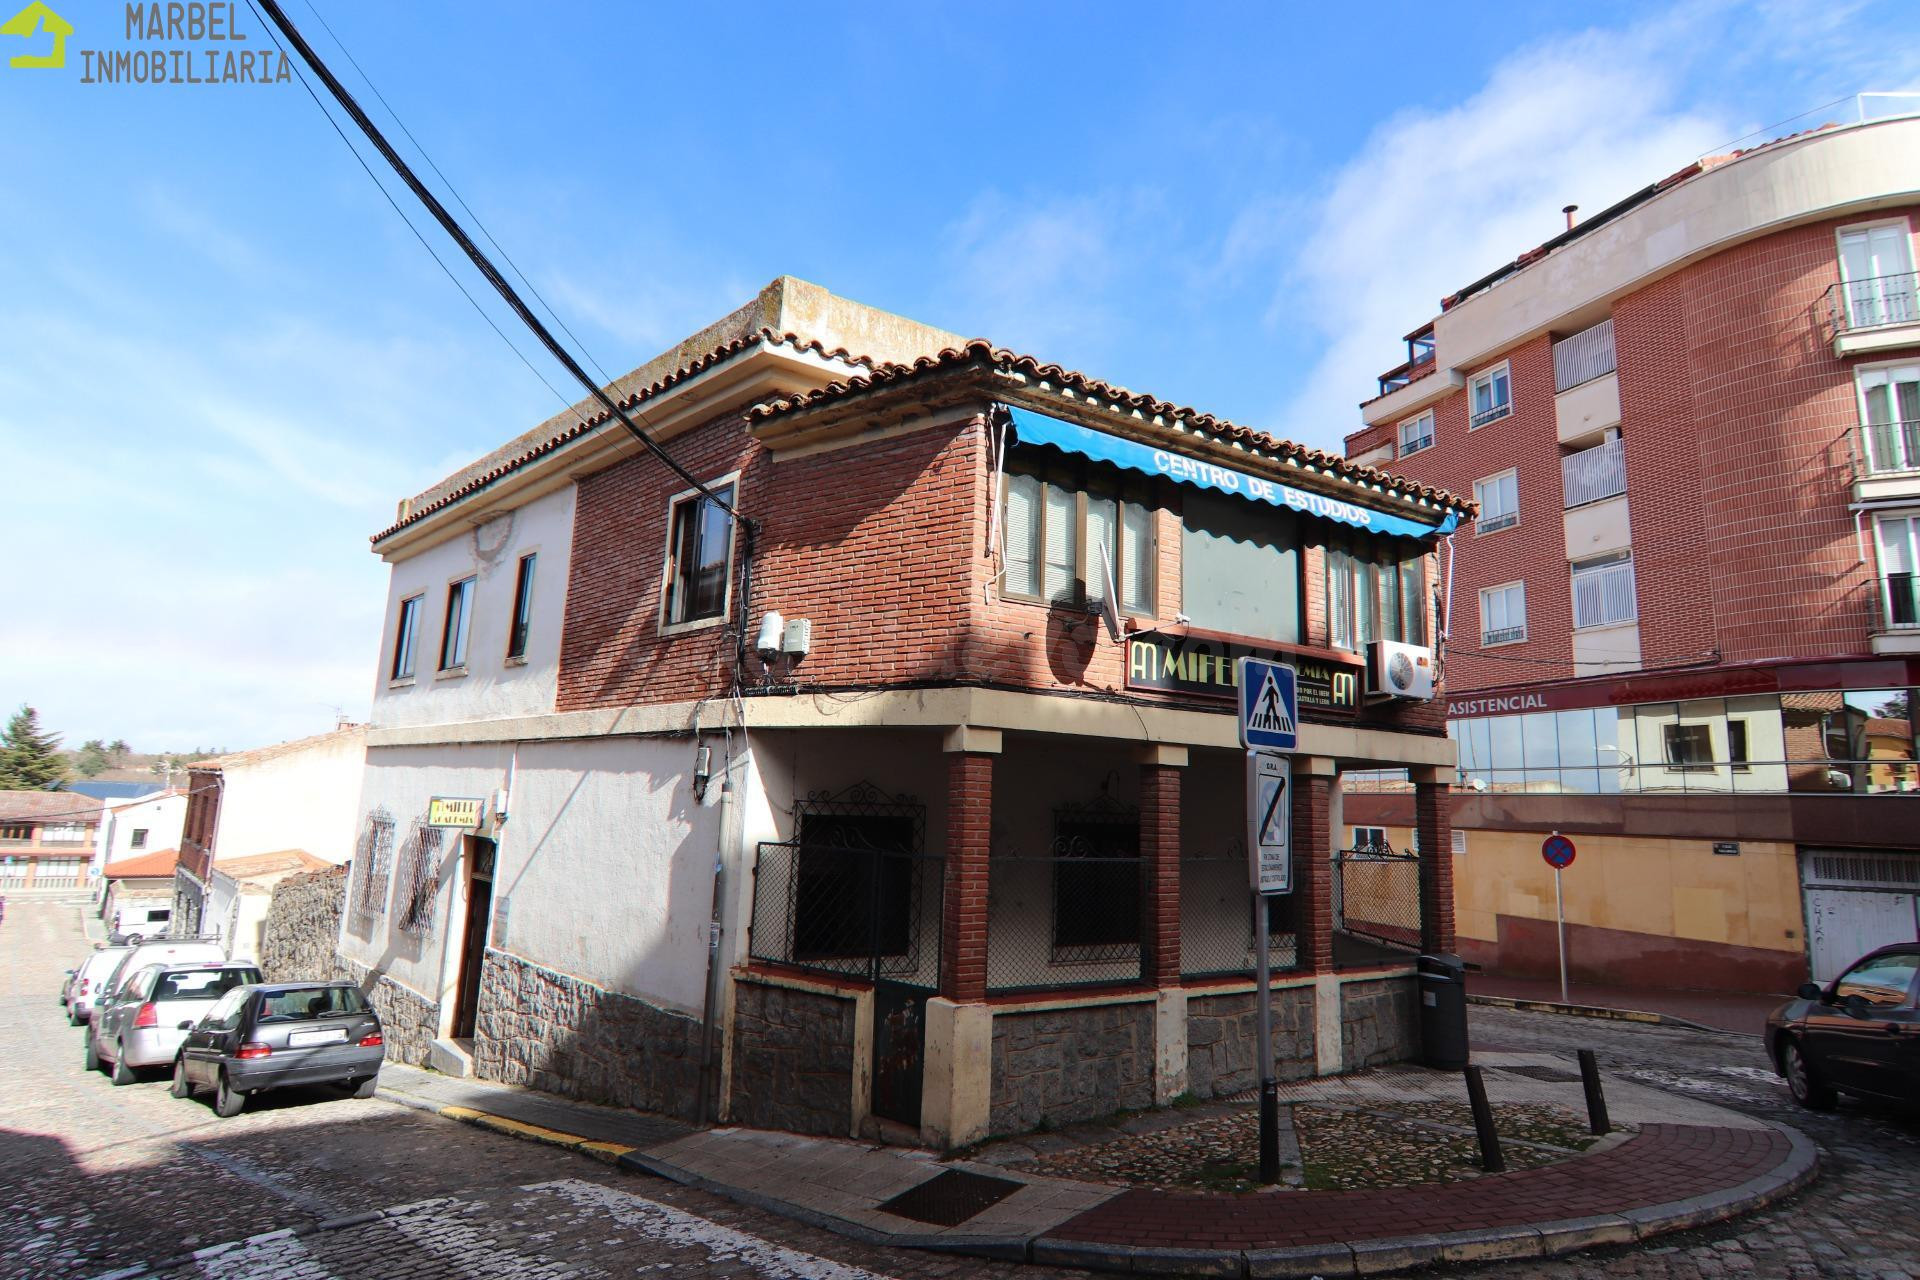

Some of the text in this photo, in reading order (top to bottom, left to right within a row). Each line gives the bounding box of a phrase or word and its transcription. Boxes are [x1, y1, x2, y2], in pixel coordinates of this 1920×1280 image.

[1154, 450, 1371, 525] CENTRO DE ESTUDIOS
[1162, 647, 1239, 687] MIFE
[1447, 693, 1548, 716] ASISTENCIAL
